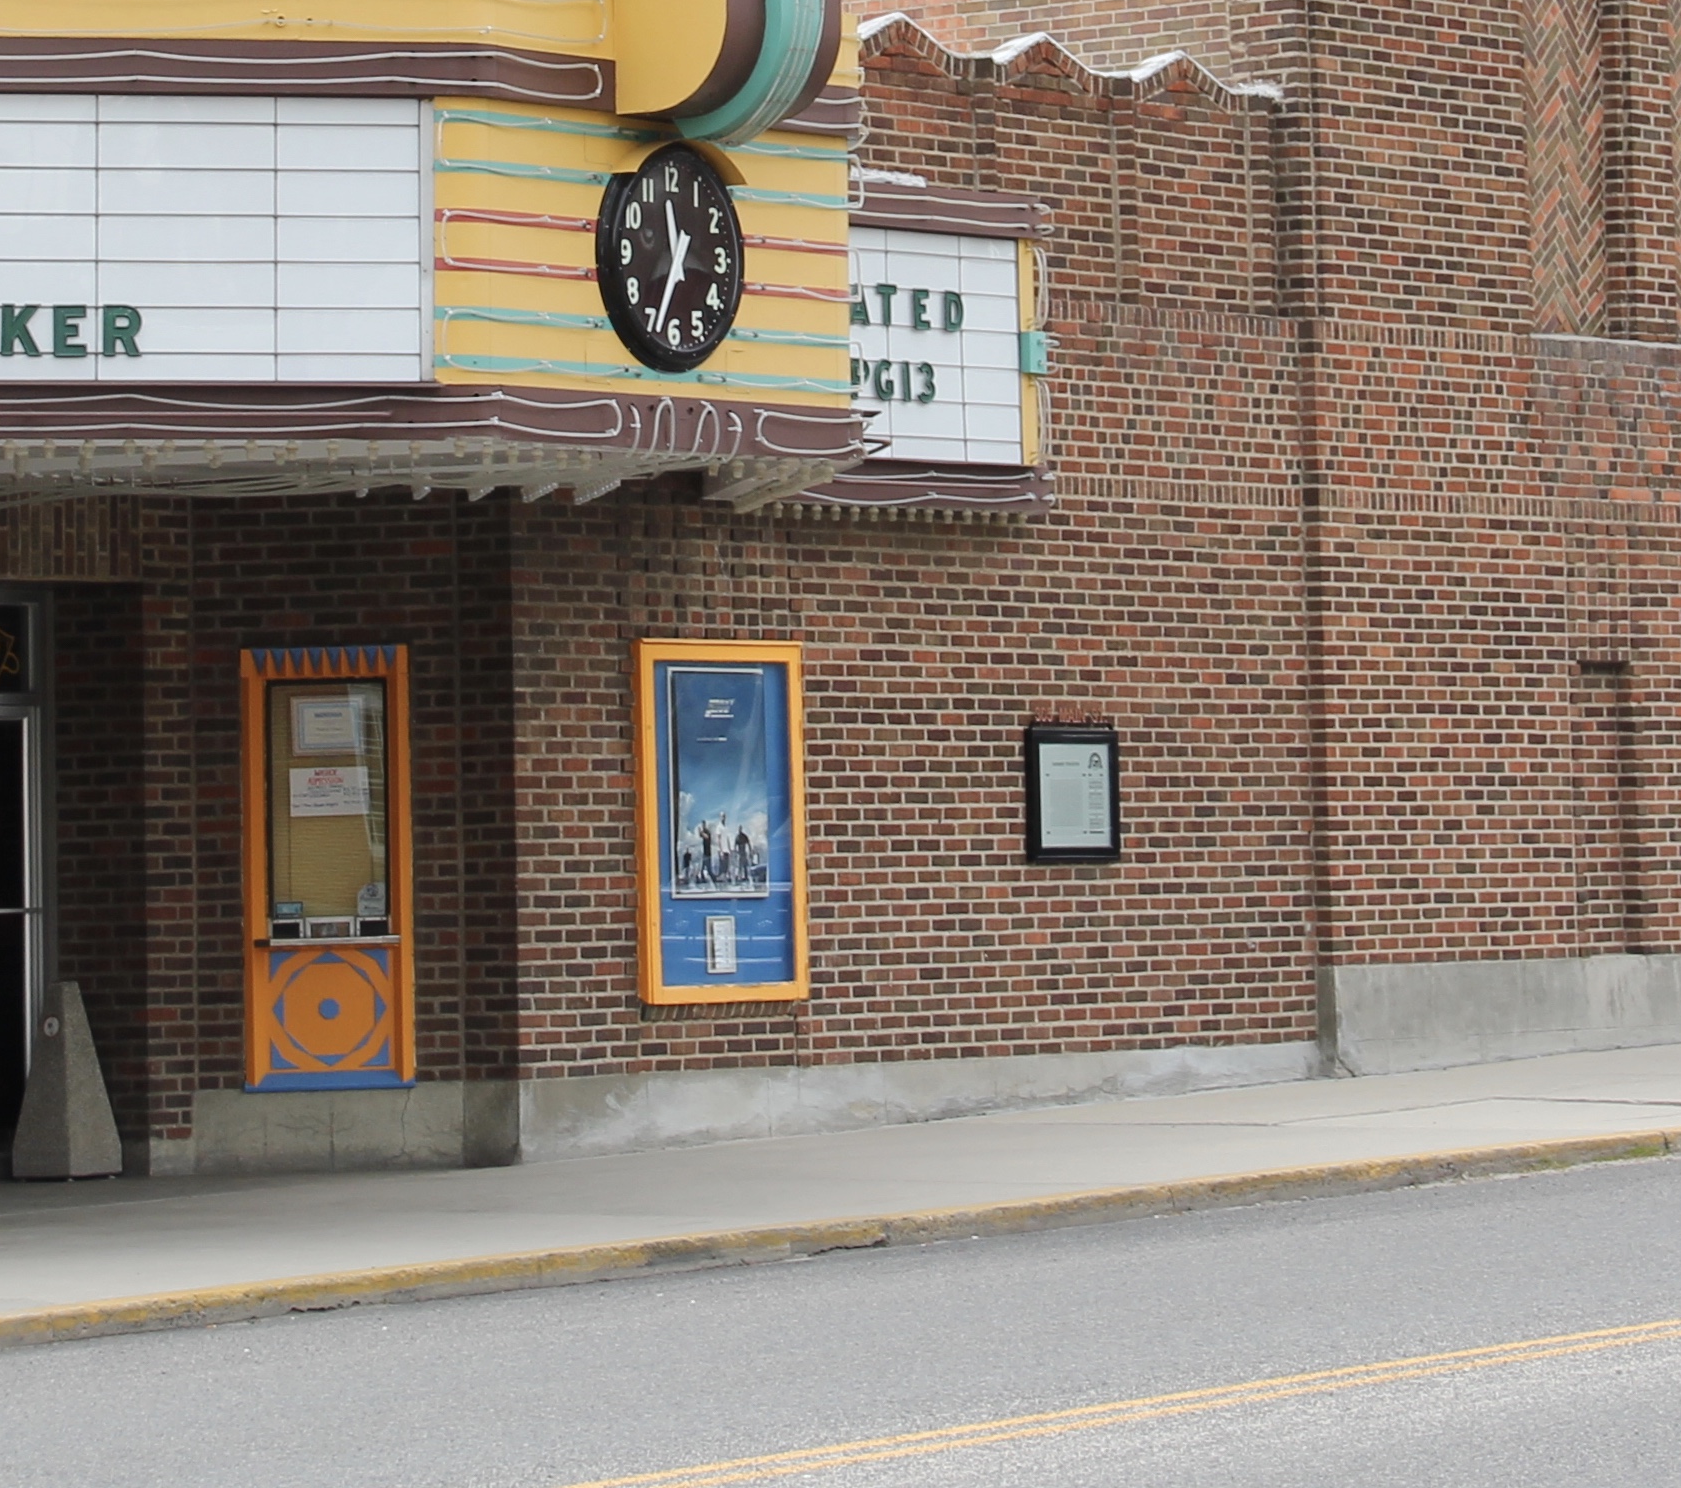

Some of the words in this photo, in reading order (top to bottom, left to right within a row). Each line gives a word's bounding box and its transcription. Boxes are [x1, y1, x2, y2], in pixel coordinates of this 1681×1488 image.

[642, 177, 655, 203] 11
[665, 165, 679, 193] 12
[693, 181, 699, 208] 1
[625, 201, 642, 229] 10
[708, 207, 720, 234] 2
[620, 238, 633, 265] 9
[714, 247, 727, 274] 3
[626, 276, 640, 305] 8
[705, 282, 721, 311] 4
[644, 307, 657, 332] 7
[667, 318, 681, 346] 6
[691, 310, 704, 337] 5
